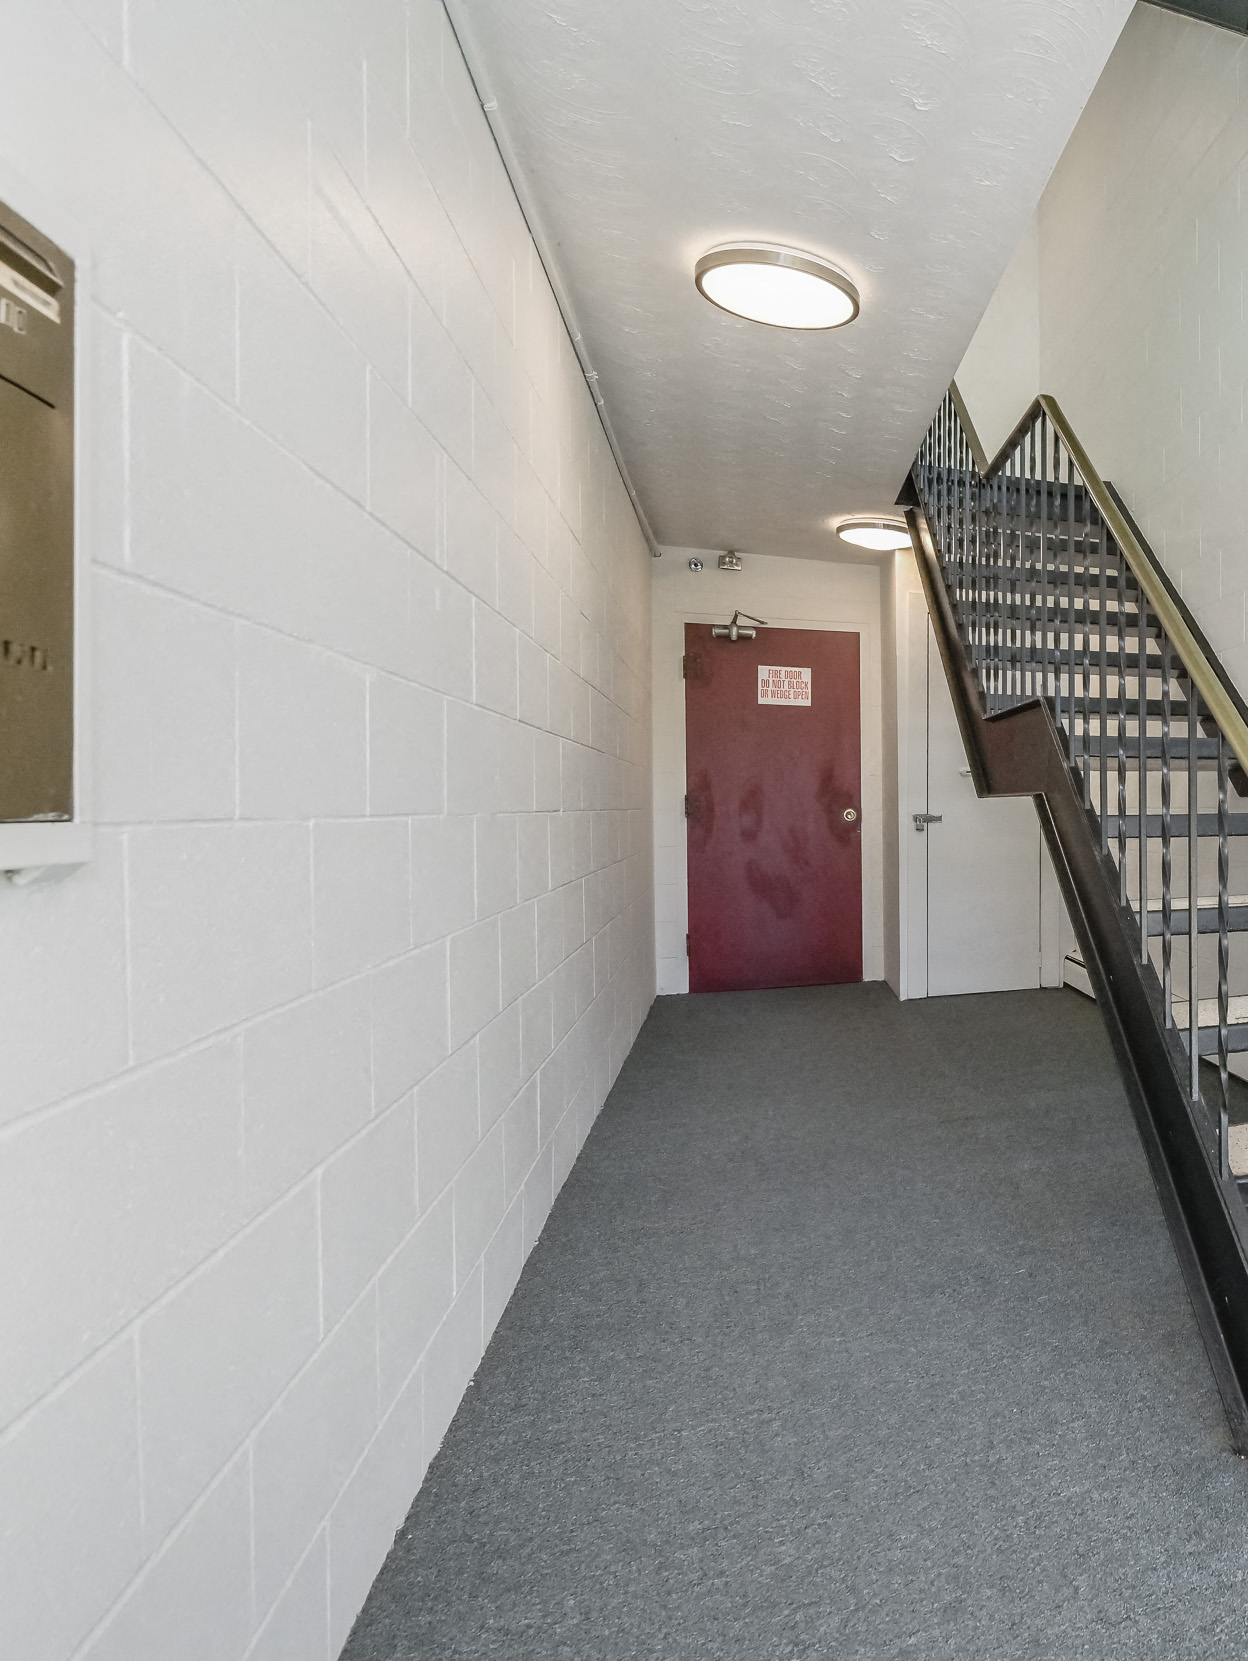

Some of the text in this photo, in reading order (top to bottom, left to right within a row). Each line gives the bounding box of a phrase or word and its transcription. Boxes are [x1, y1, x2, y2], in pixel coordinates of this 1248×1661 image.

[768, 669, 802, 680] FIRE DOOR
[761, 679, 809, 690] DO NOT BLOCK
[760, 689, 810, 700] OR WEDGE OPEN
